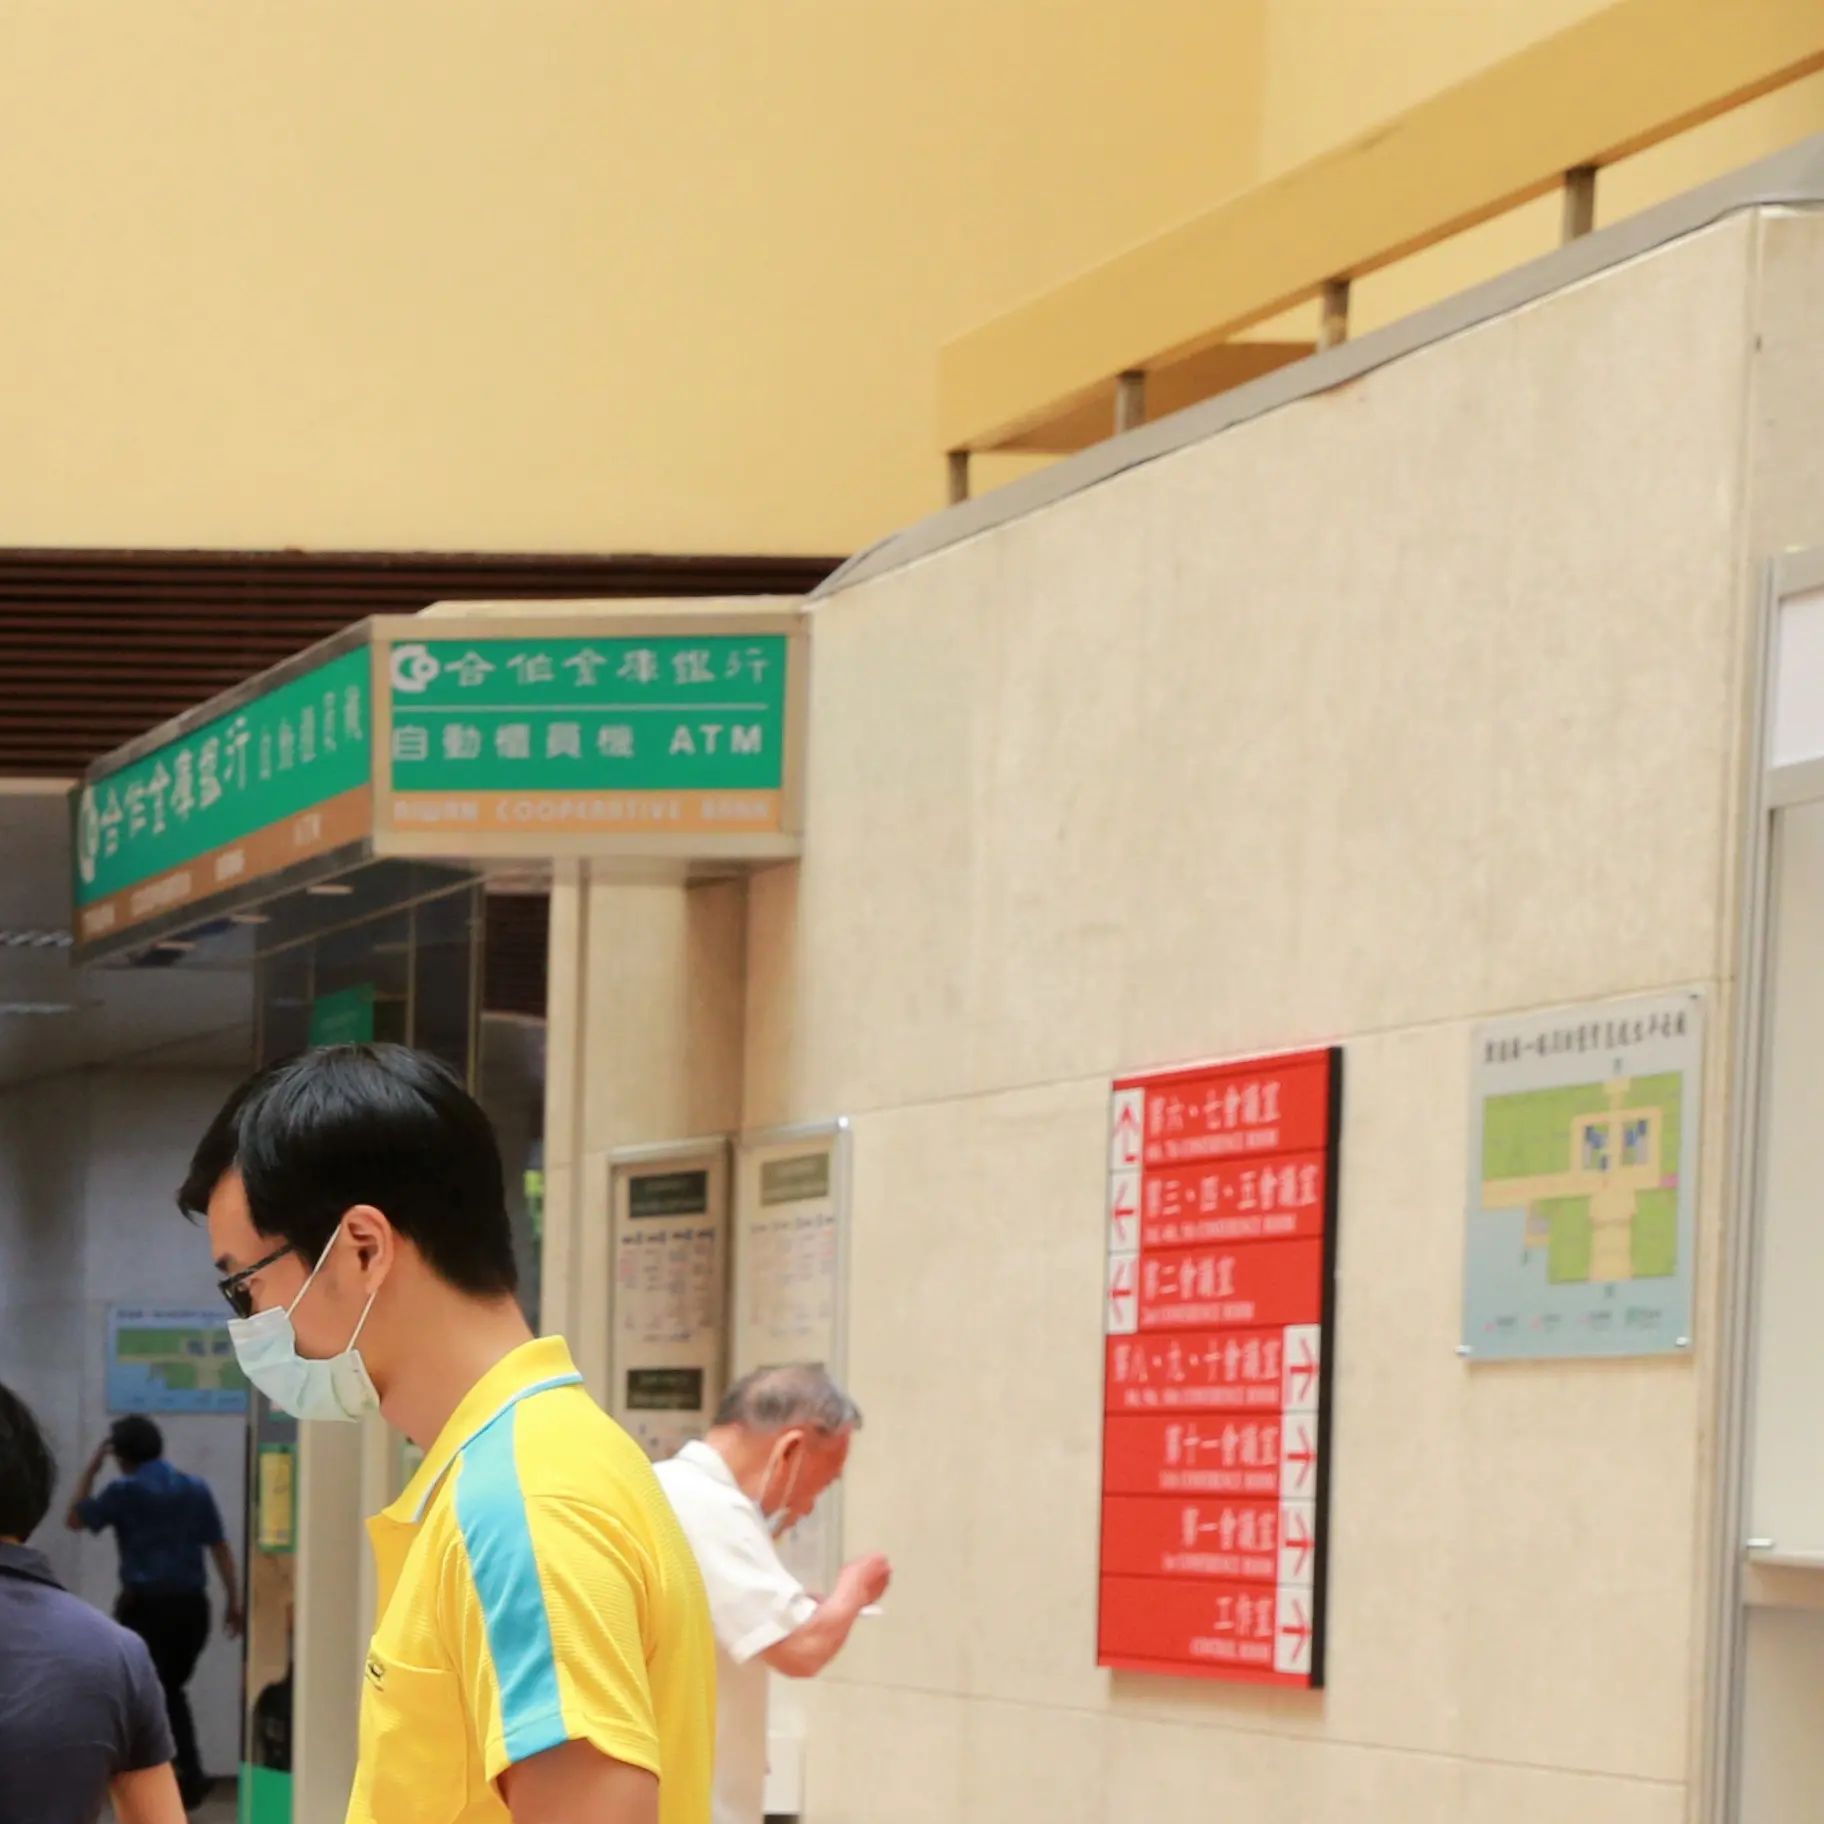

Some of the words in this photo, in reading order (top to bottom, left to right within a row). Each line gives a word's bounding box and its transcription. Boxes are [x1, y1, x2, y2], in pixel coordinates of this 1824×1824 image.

[392, 722, 634, 761] 自動櫃員機
[668, 725, 763, 756] ATM
